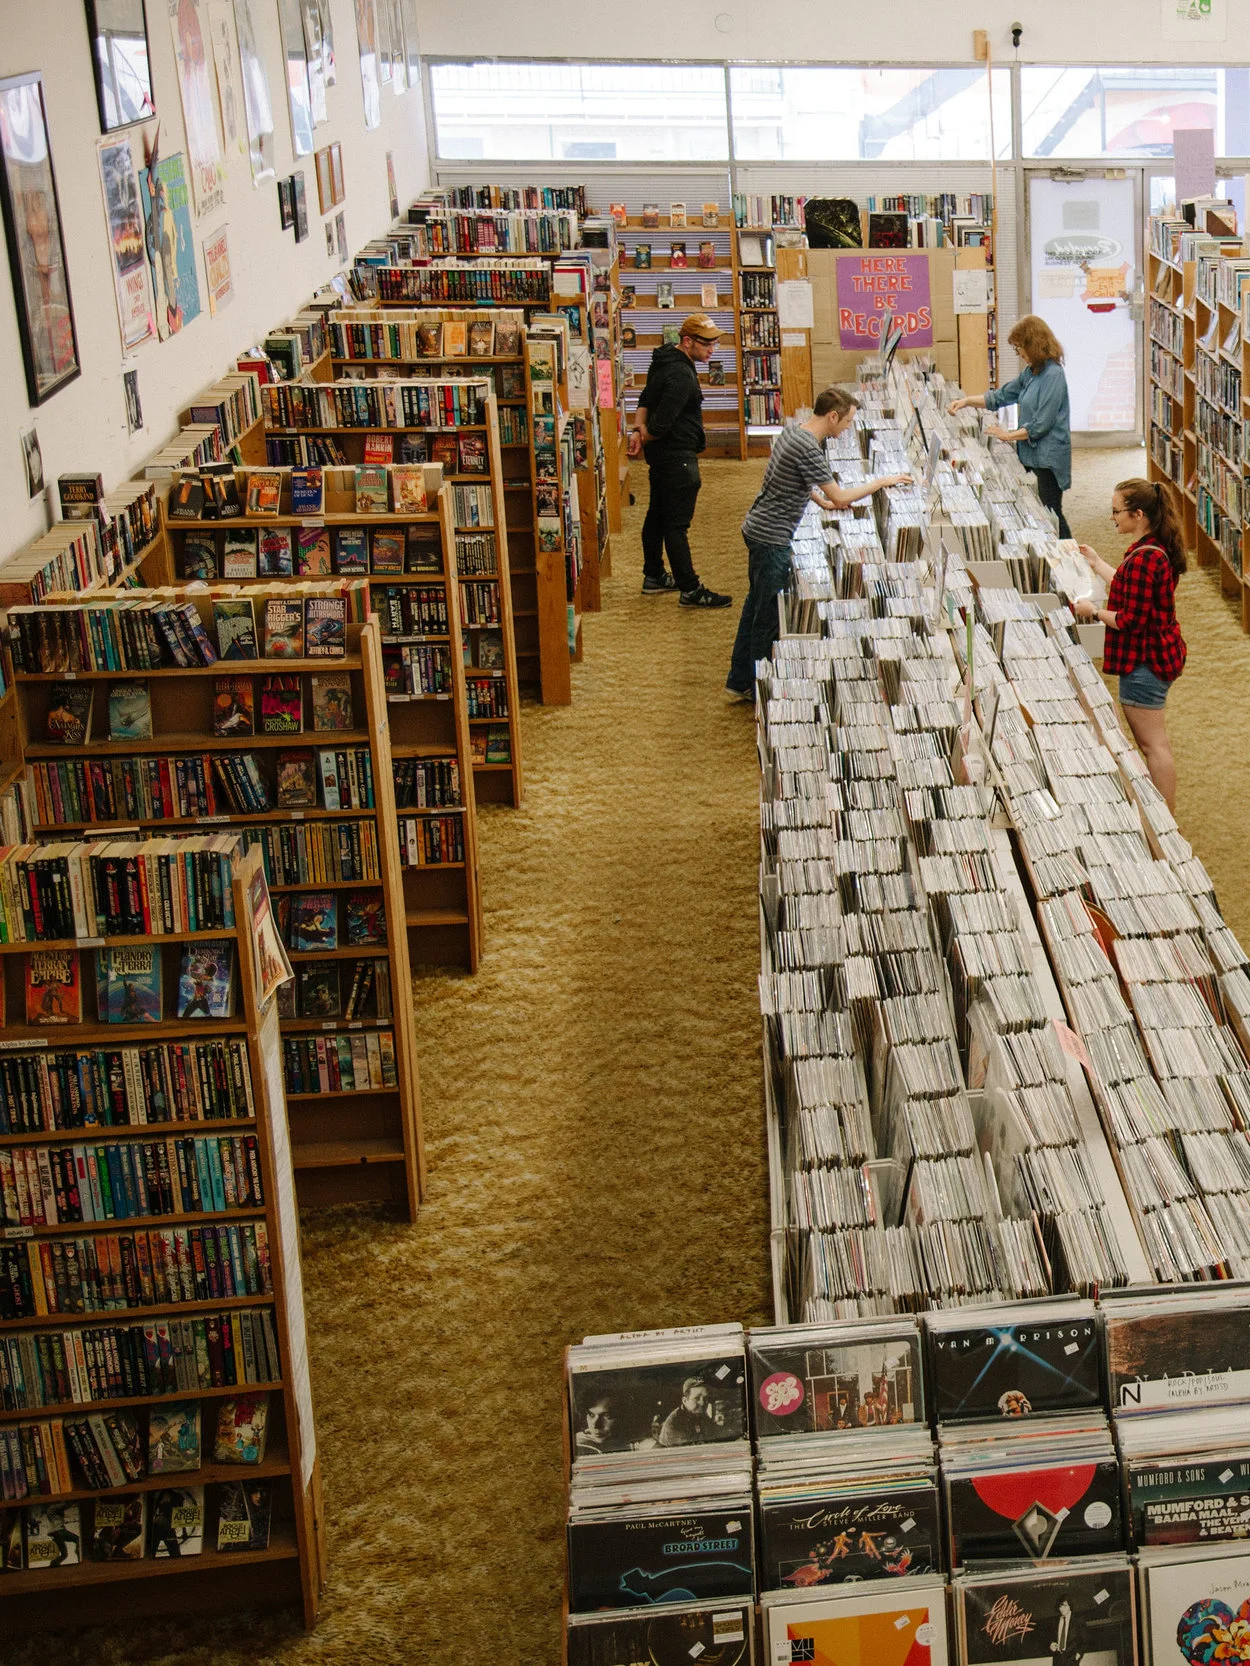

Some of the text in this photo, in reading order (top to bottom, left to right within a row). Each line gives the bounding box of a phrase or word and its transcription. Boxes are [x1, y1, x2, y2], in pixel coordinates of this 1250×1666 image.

[861, 257, 907, 273] HERE
[851, 275, 912, 292] THERE
[874, 294, 898, 310] BE
[840, 307, 932, 339] RECORDS
[366, 434, 393, 444] ROBERT
[366, 443, 393, 452] RANKIN
[69, 486, 88, 494] TERRY
[63, 493, 95, 501] GOODKIND
[268, 605, 286, 613] STAR
[309, 601, 344, 610] STRANGE
[268, 613, 301, 622] RIGGER'S
[268, 622, 286, 630] WAY
[263, 676, 300, 690] JAM
[265, 721, 299, 731] CROSHAW
[32, 951, 56, 960] AGENT
[112, 950, 153, 963] FLANDRY
[32, 960, 69, 971] TERRAN
[121, 961, 153, 971] TERRA
[31, 969, 72, 985] EMPIRE
[938, 1328, 1091, 1349] VAN MRRISON
[1168, 1375, 1224, 1388] ROCK/POP/SOUL
[1123, 1383, 1141, 1405] N
[1137, 1472, 1175, 1487] MUMFORD
[1178, 1470, 1183, 1483] &
[1186, 1468, 1206, 1481] SONS
[1147, 1499, 1224, 1516] MUMFORD
[1226, 1497, 1238, 1507] &
[793, 1502, 906, 1529] Circle of Love
[823, 1519, 849, 1527] STEVE
[857, 1515, 887, 1523] MILLER
[1154, 1508, 1238, 1524] BAABA MAAL,
[625, 1519, 698, 1530] PAUL McCARTNEY
[1200, 1519, 1223, 1528] THE
[1200, 1528, 1209, 1536] &
[663, 1539, 738, 1554] BROAD STREET
[1209, 1583, 1231, 1594] Jason
[984, 1595, 1024, 1632] Eddie
[988, 1612, 1036, 1645] Money
